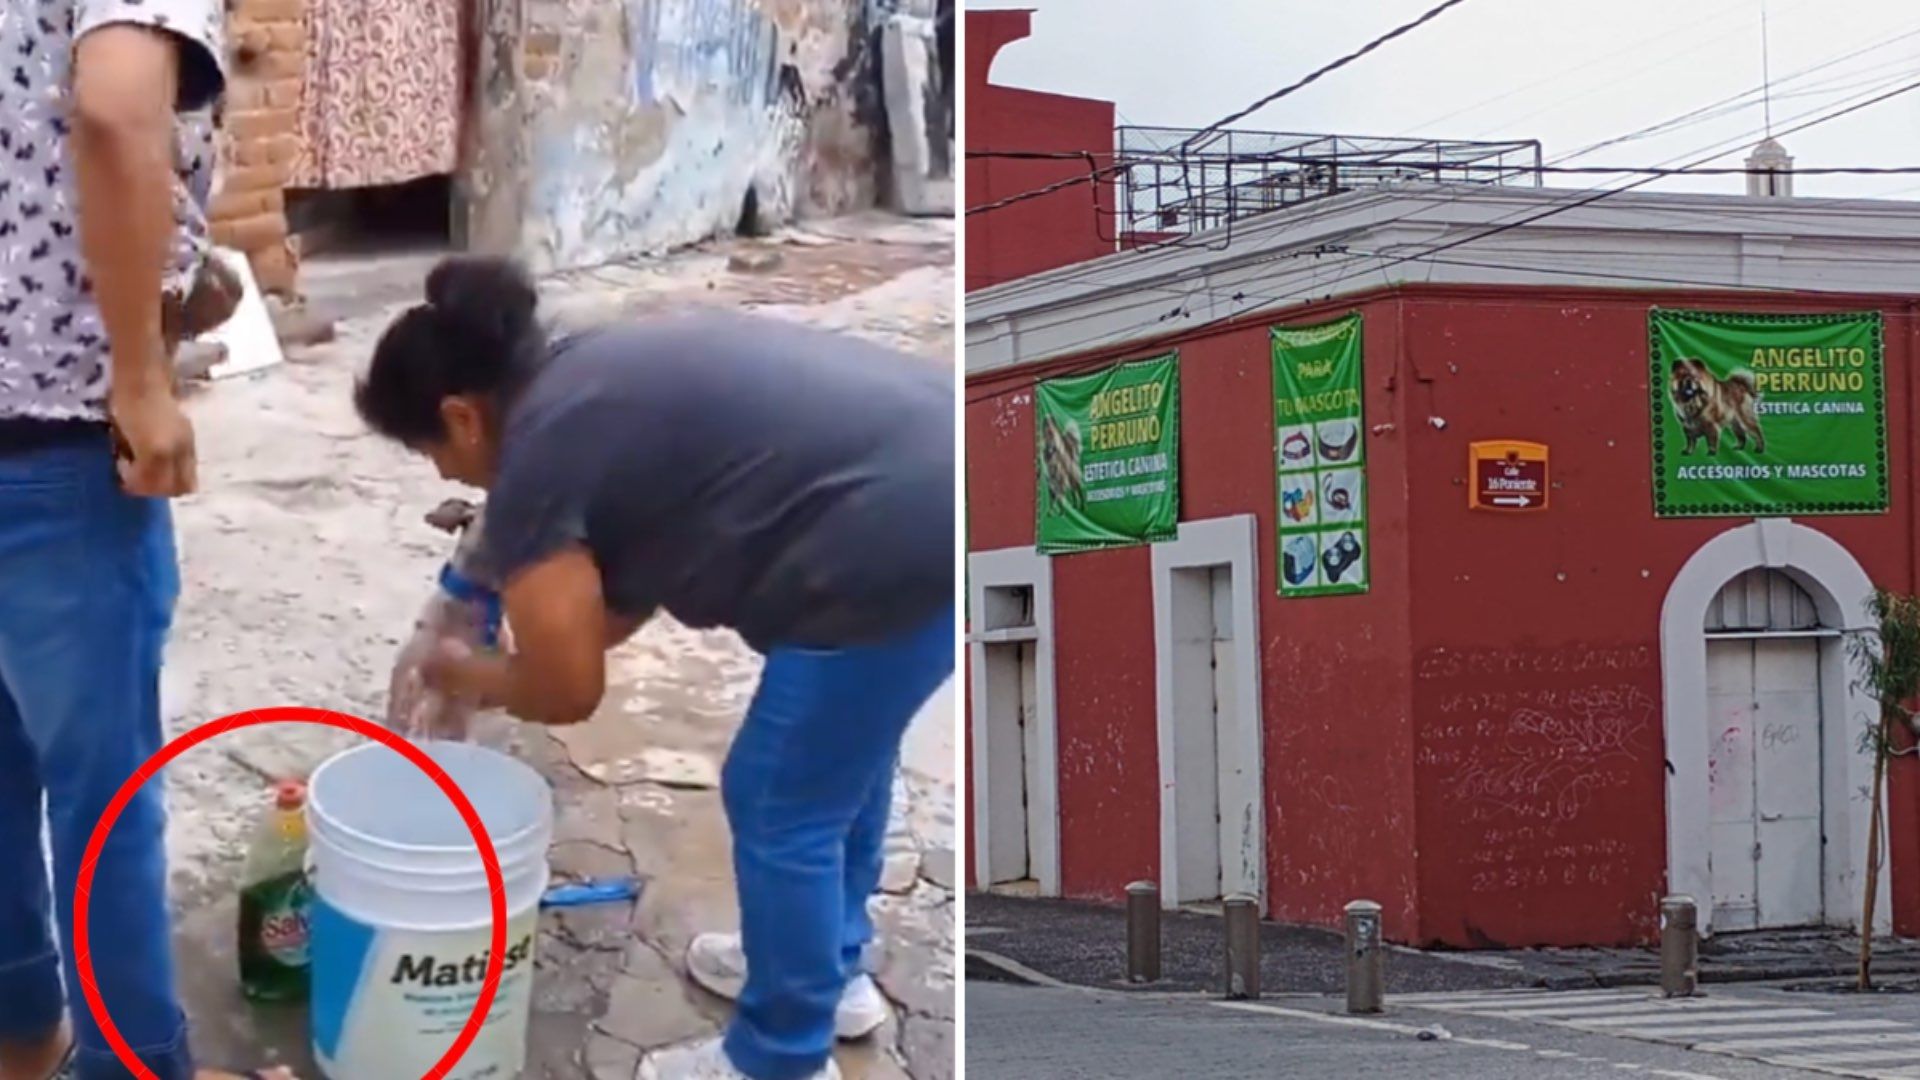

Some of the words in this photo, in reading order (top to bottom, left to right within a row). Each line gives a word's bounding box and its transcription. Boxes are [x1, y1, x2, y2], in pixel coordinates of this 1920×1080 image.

[1751, 348, 1866, 367] ANGELITO
[1755, 371, 1864, 391] PERRUNO
[1089, 382, 1162, 419] ANGELITO
[1295, 388, 1360, 415] MASCOTA
[1752, 402, 1811, 414] ESTETICA
[1813, 402, 1865, 414] CANINA
[1091, 415, 1160, 451] PERRUNO
[1084, 459, 1126, 482] ESTETICA
[1677, 465, 1770, 480] ACCESORIOS
[1773, 465, 1783, 478] Y
[1787, 464, 1867, 478] MASCOTAS
